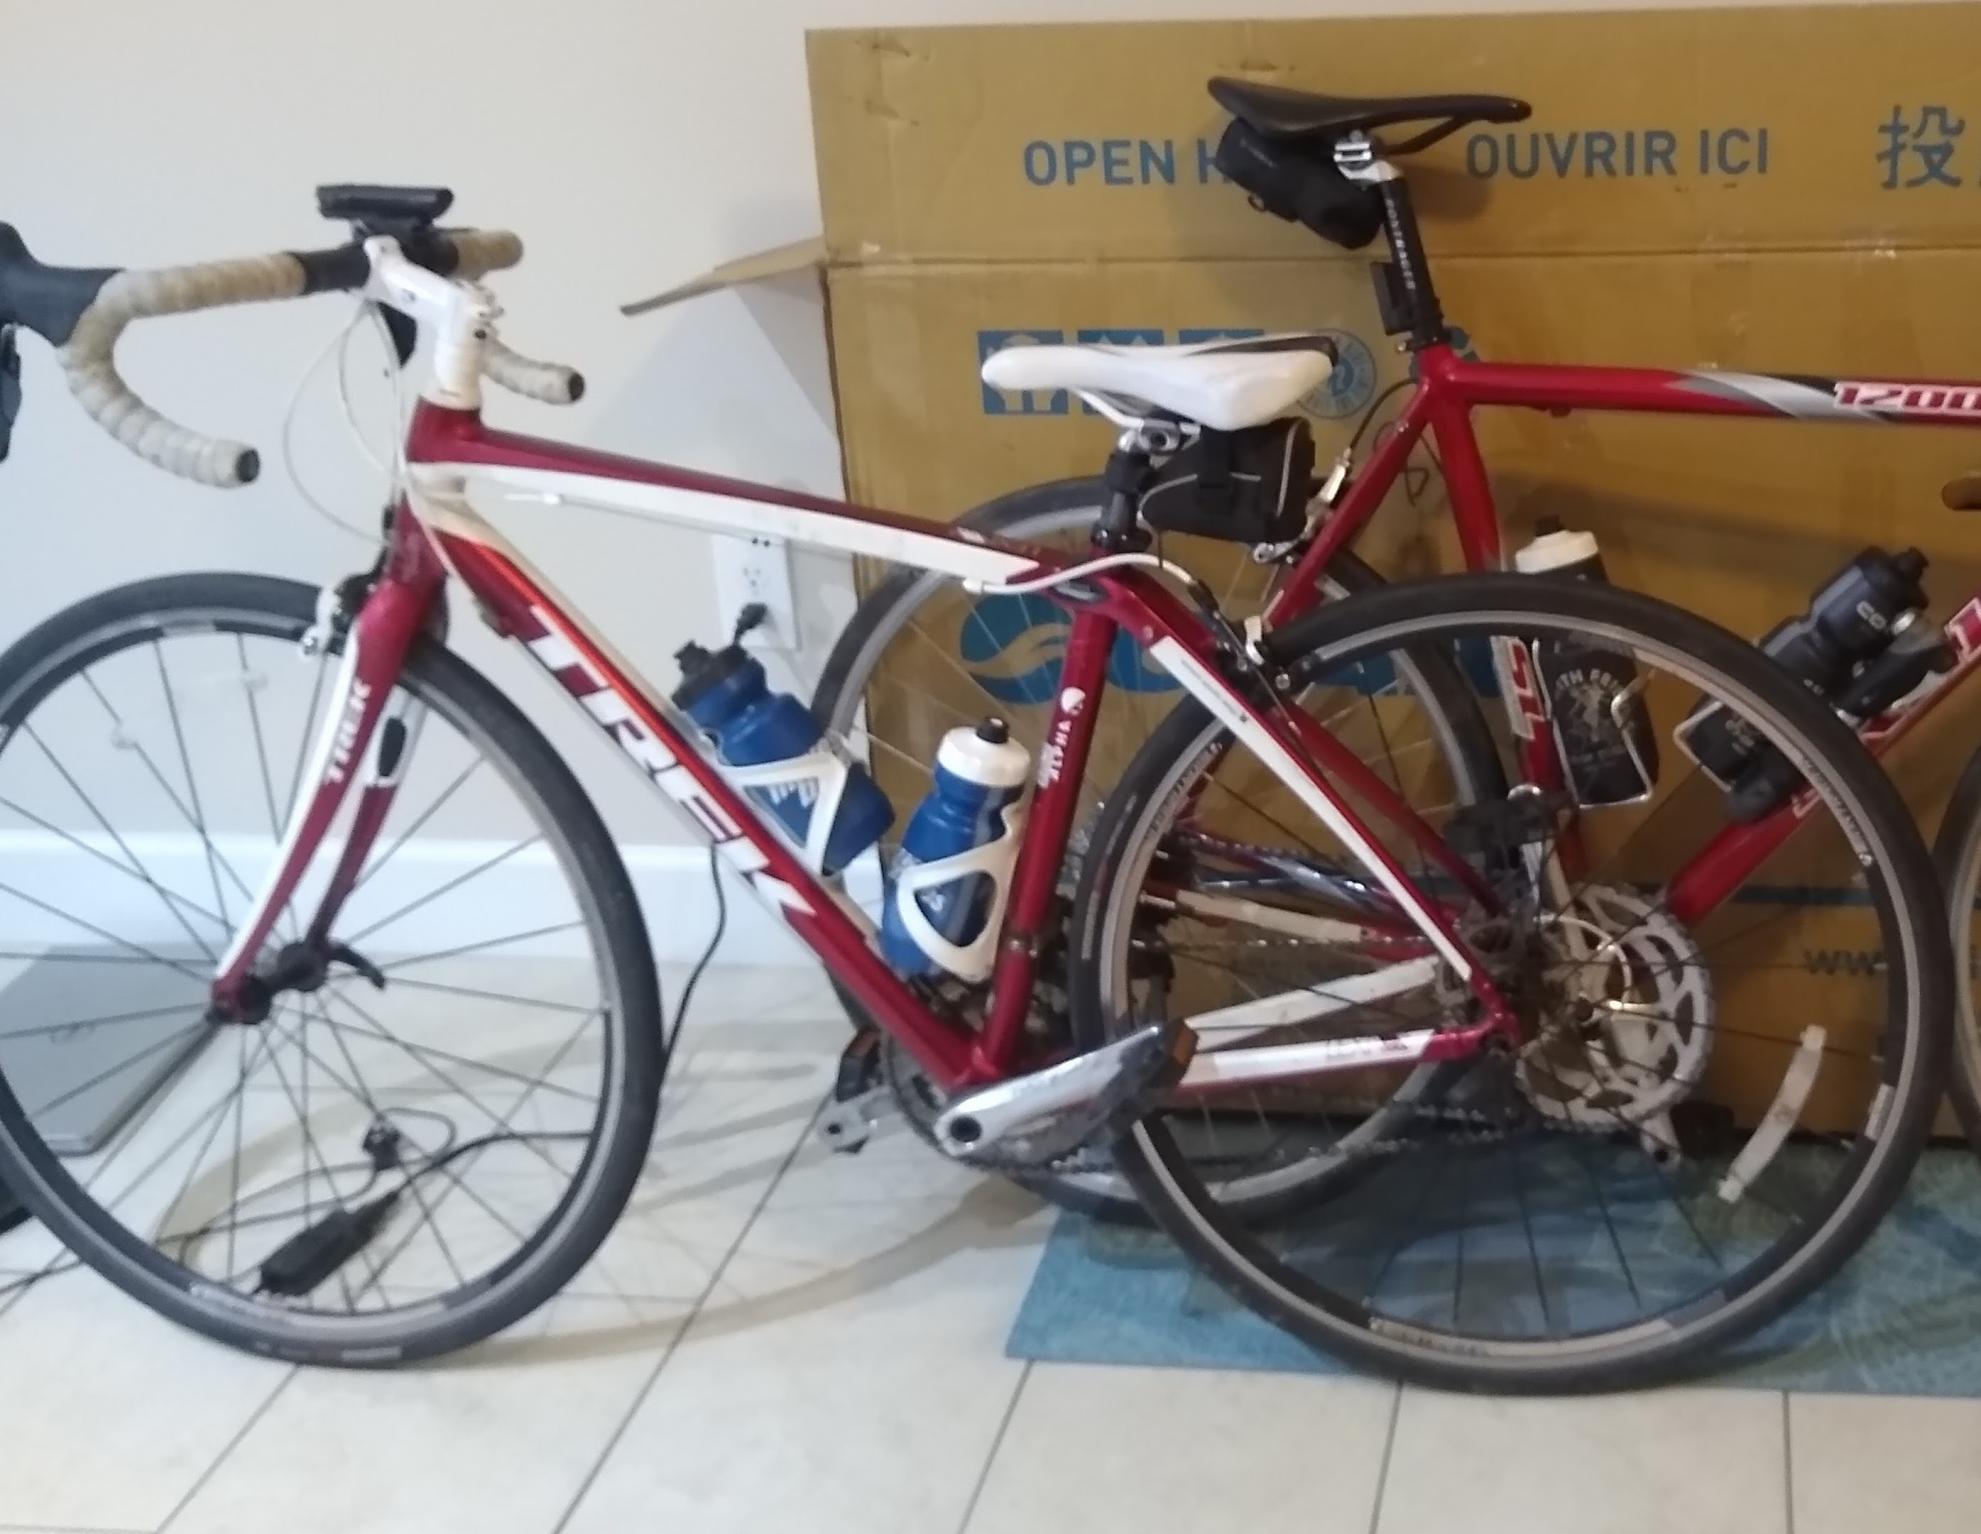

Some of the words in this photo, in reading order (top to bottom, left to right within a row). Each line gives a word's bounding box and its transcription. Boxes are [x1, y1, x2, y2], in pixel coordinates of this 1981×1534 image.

[1024, 139, 1176, 186] OPEN
[1466, 130, 1678, 180] OUVRIR
[1700, 127, 1769, 175] ICI
[1876, 103, 1966, 190] 投
[528, 603, 817, 917] TREK
